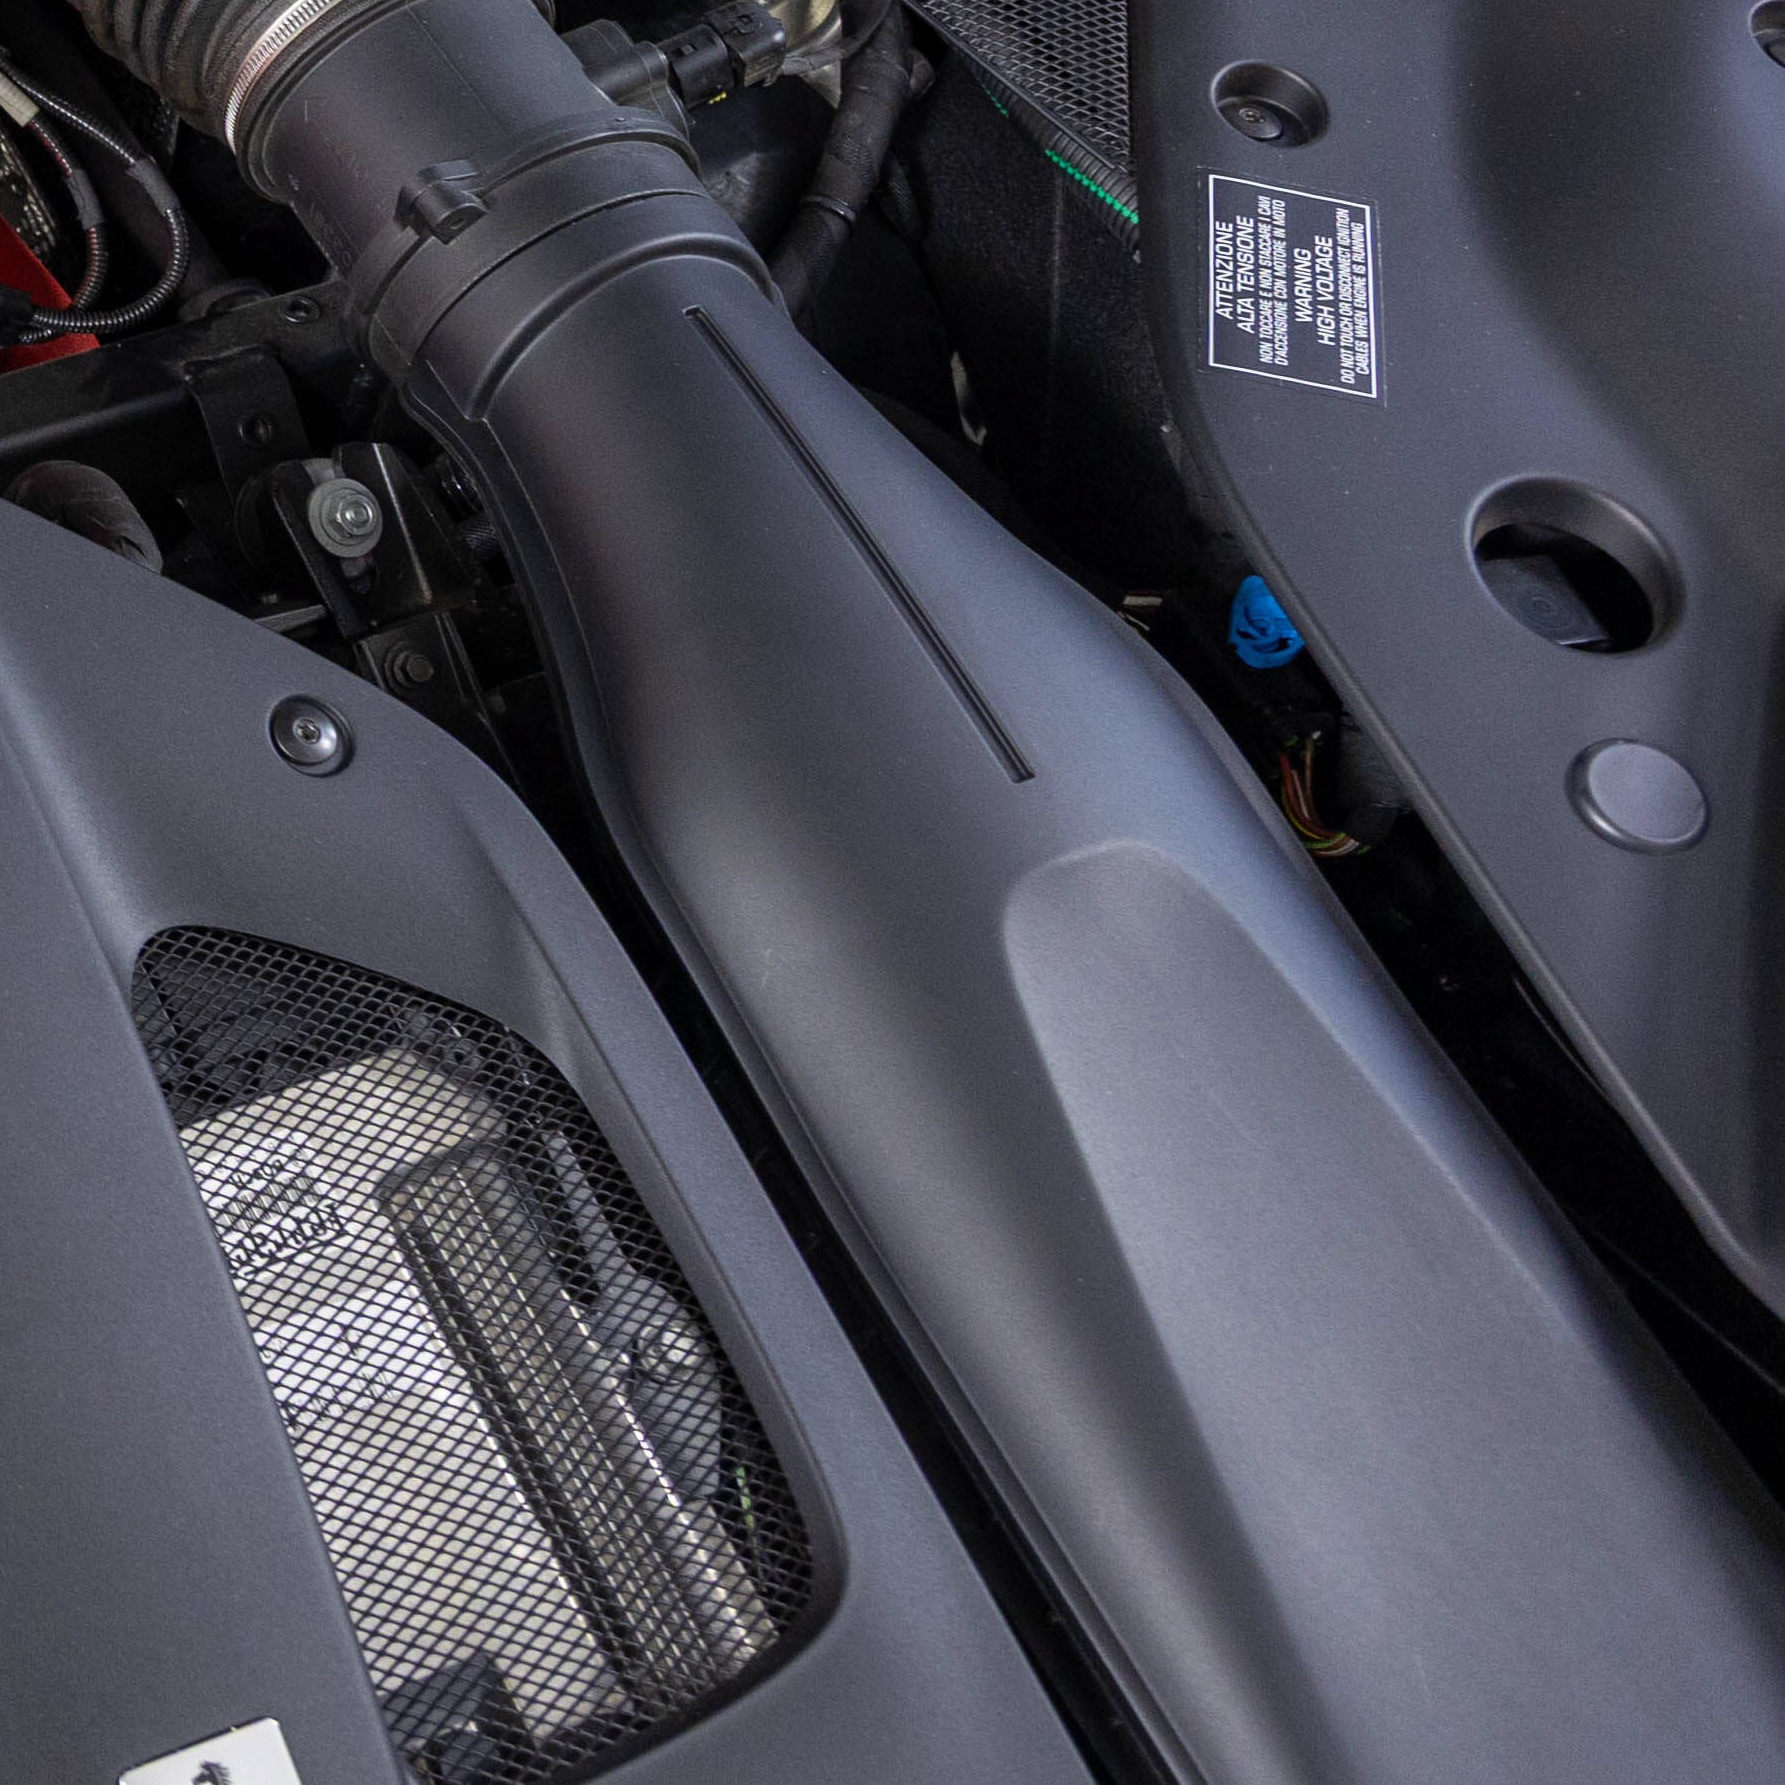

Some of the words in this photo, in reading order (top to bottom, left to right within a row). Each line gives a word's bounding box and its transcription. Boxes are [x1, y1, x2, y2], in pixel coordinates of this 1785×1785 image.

[1258, 194, 1271, 215] CAVI
[1272, 198, 1285, 226] MOTO
[1258, 221, 1272, 266] STACCARE
[1272, 226, 1285, 238] IN
[1336, 207, 1350, 246] IGNITION
[1351, 221, 1365, 262] RUNNING
[1215, 219, 1233, 319] ATTENZIONE
[1236, 214, 1254, 294] TENSIONE
[1272, 238, 1286, 277] MOTORE
[1314, 234, 1334, 302] VOLTAGE
[1258, 267, 1272, 289] NON
[1273, 277, 1287, 299] CON
[1293, 246, 1313, 323] WARNING
[1337, 246, 1352, 301] DISCONNECT
[1353, 275, 1367, 308] ENGINE
[1237, 295, 1255, 334] ALTA
[1259, 298, 1273, 339] TOCCARE
[1316, 304, 1335, 345] HIGH
[1339, 301, 1353, 316] OR
[1354, 309, 1368, 339] WHEN
[1273, 299, 1288, 366] D'ACCENSIONE
[1339, 316, 1354, 347] TOUCH
[1259, 341, 1273, 363] NON
[1340, 348, 1354, 368] NOT
[1355, 339, 1369, 375] CABLES
[1341, 368, 1355, 384] DO
